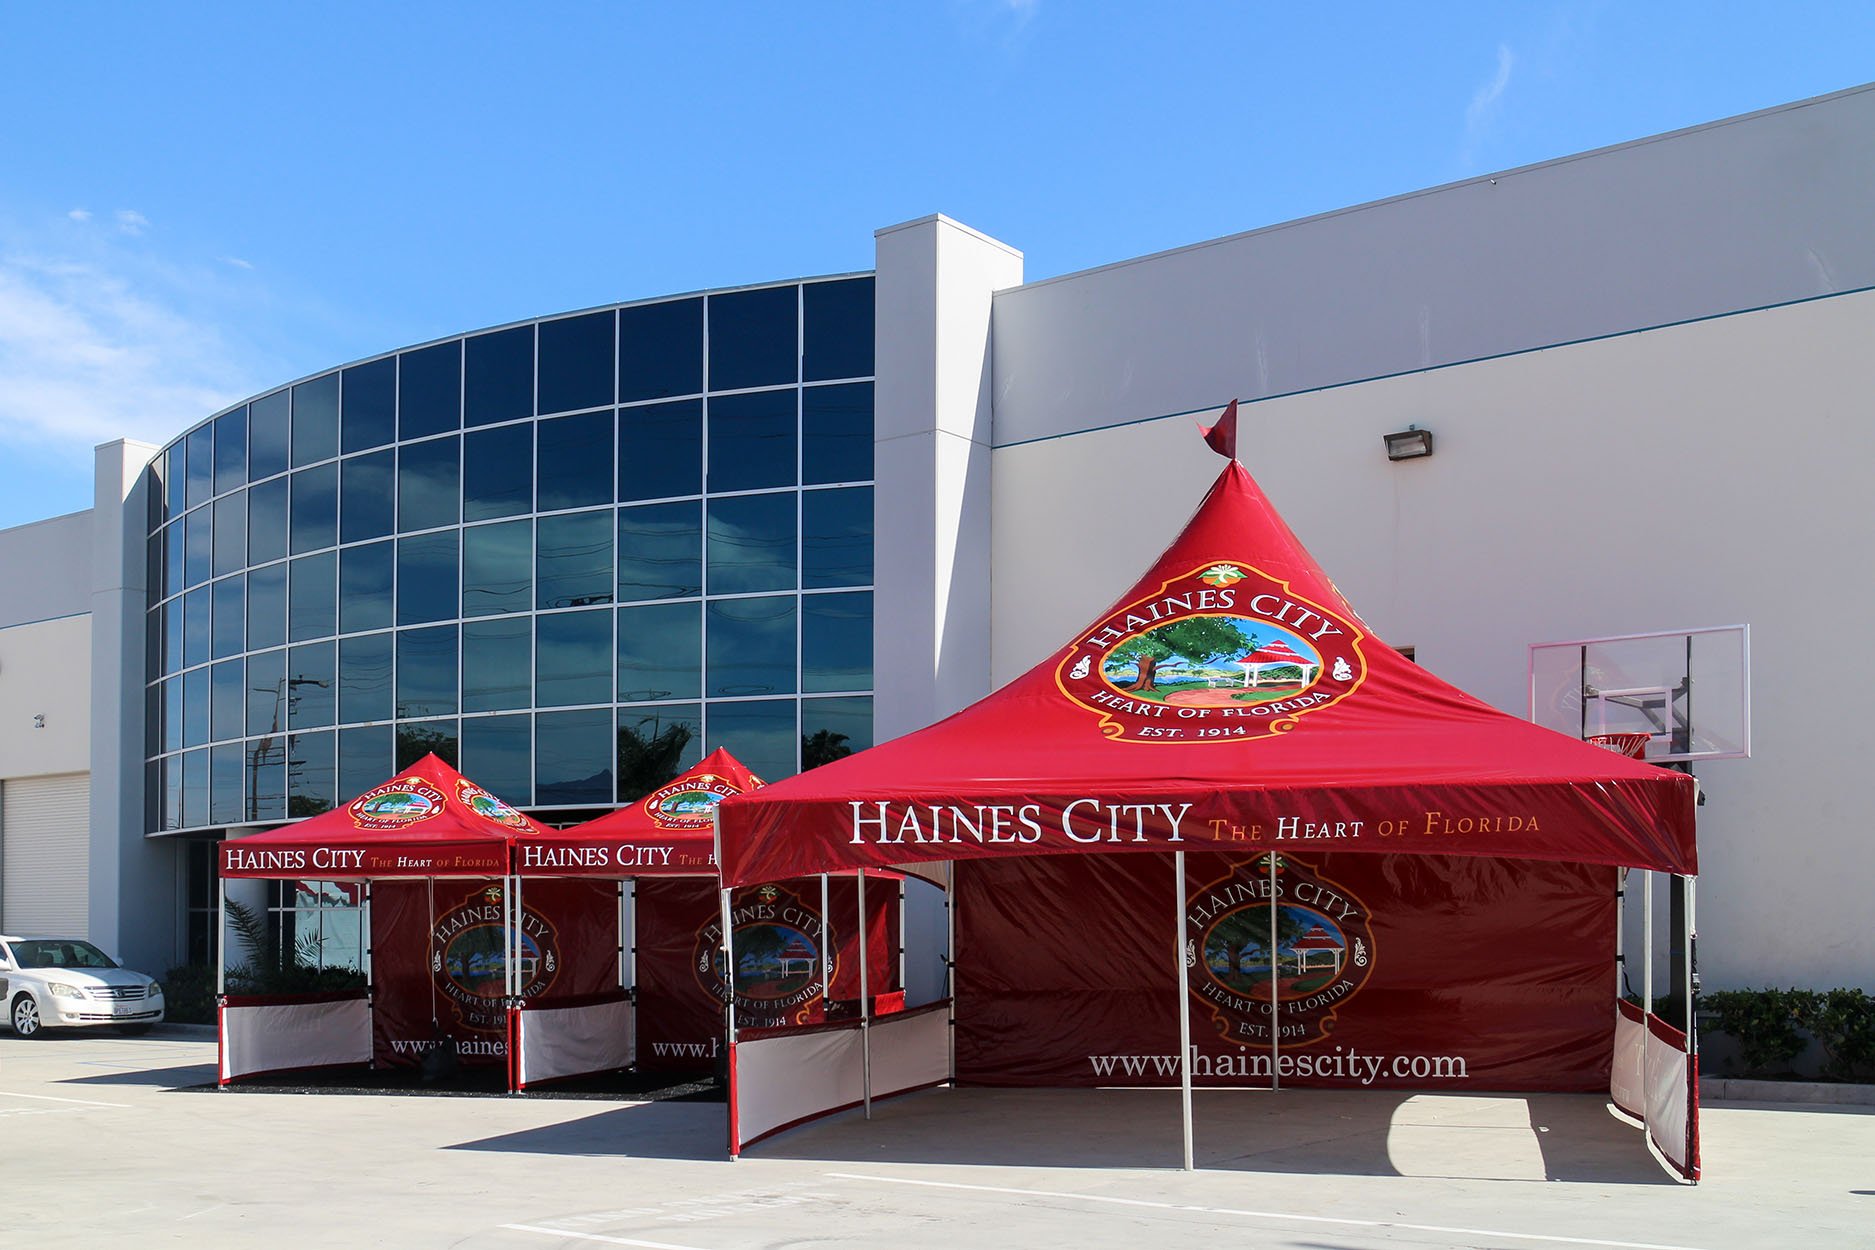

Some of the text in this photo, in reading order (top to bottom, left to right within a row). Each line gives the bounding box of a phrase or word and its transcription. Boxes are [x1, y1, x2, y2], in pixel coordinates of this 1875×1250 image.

[1087, 589, 1343, 649] HAINES CITY
[1090, 690, 1331, 719] HEART OF FLORIDA
[1137, 725, 1246, 738] EST. 1914
[363, 784, 443, 802] HAINES CITY
[658, 782, 711, 798] HAINES
[713, 784, 740, 797] CIT
[848, 801, 1042, 844] HAINES
[1061, 798, 1193, 843] CITY
[225, 849, 306, 870] HAINES
[312, 848, 366, 869] CITY
[523, 845, 609, 868] HAINES
[616, 844, 675, 867] CITY
[1187, 878, 1358, 930] HAINES CITY
[436, 905, 501, 944] HAINES
[704, 904, 823, 943] HINES CITY
[445, 981, 483, 1007] HEART
[774, 982, 823, 1009] FLORIDA
[1202, 981, 1255, 1014] HEART
[1288, 978, 1354, 1014] FLORIDA
[764, 1016, 786, 1027] 1914
[1239, 1022, 1306, 1037] EST. 1914
[1088, 1045, 1469, 1084] wwwhainescity.com
